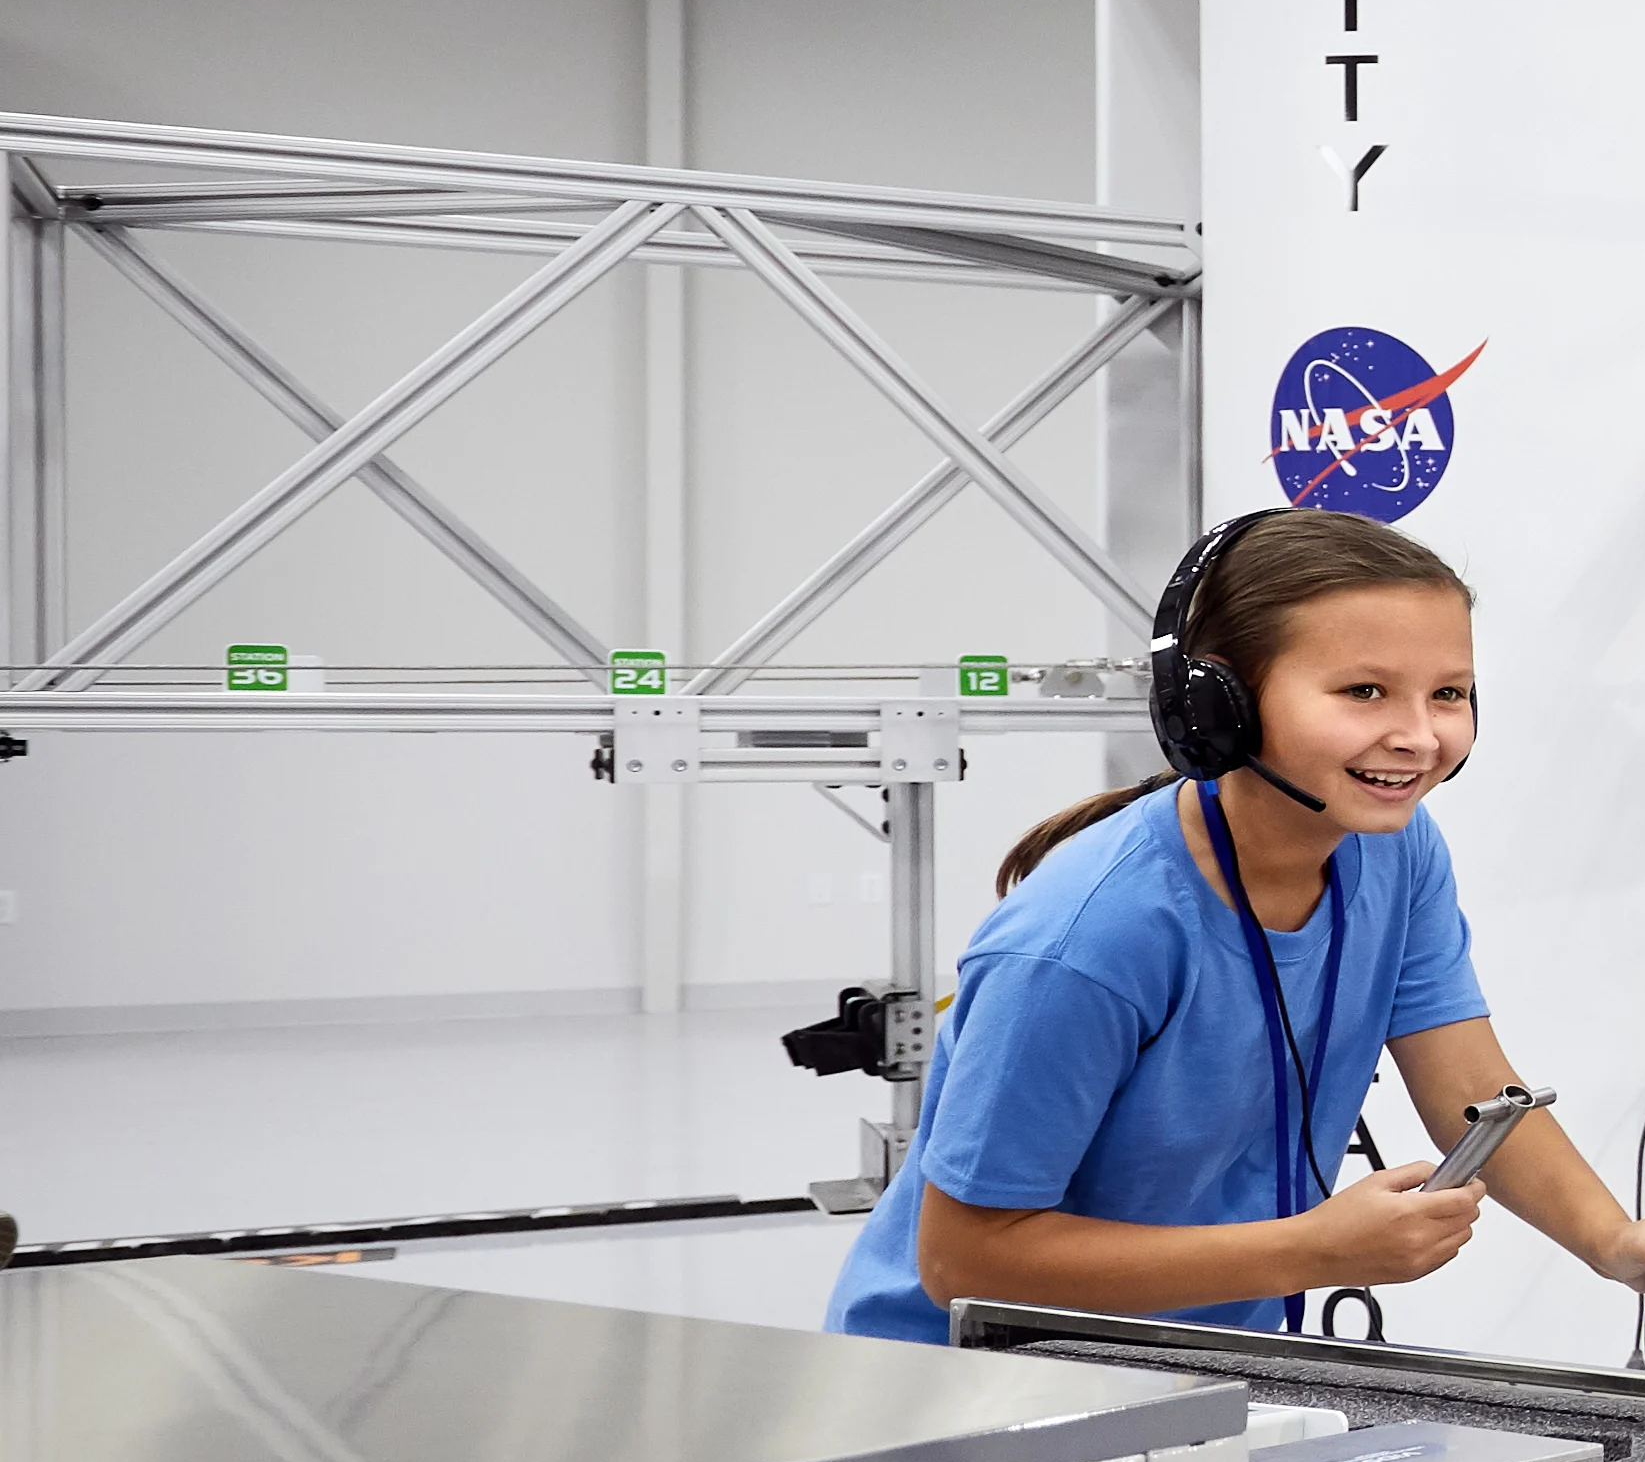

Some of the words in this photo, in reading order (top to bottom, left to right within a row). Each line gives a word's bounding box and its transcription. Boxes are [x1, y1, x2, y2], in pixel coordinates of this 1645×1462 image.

[1278, 407, 1446, 453] NASA
[614, 669, 663, 690] 24
[967, 671, 999, 692] 12
